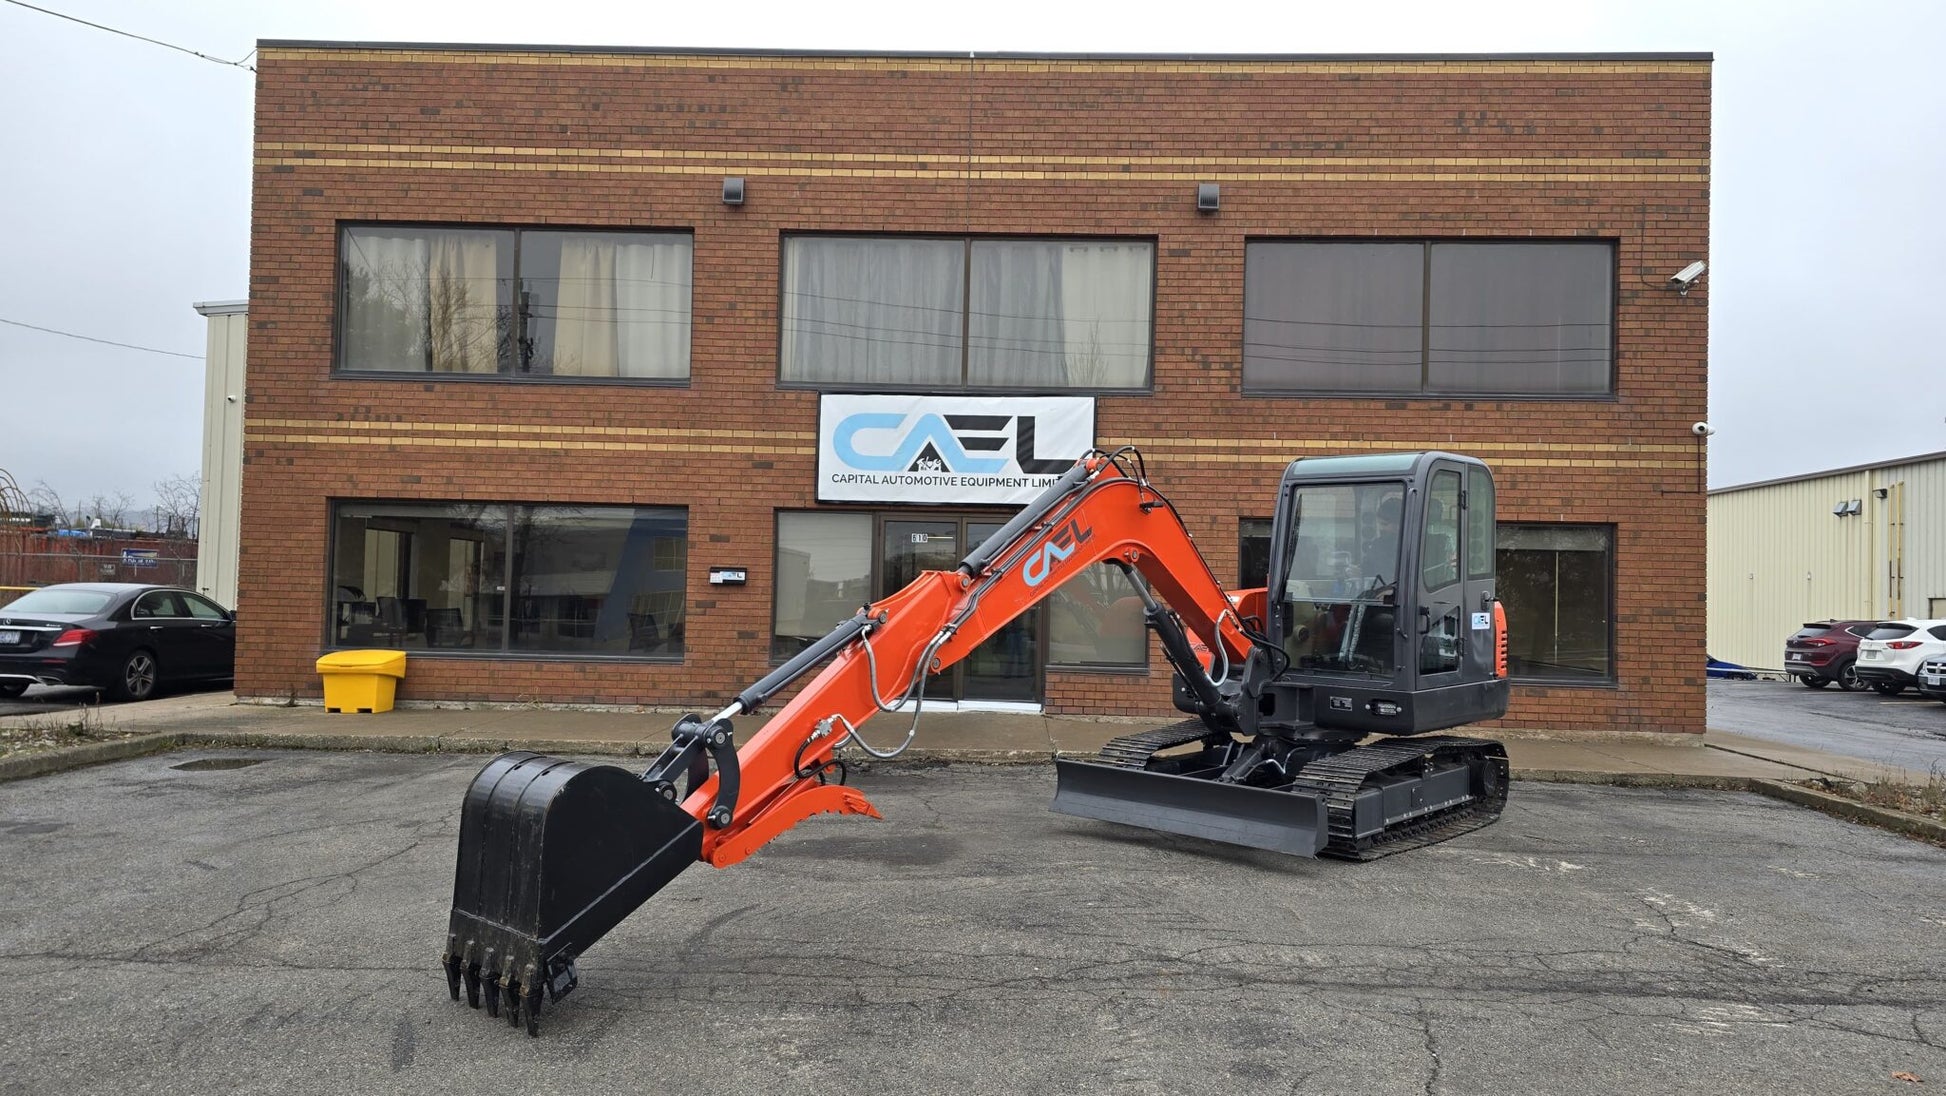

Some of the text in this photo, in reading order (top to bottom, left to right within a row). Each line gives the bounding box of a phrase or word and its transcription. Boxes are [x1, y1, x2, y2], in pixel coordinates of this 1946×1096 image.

[833, 413, 1079, 474] CAEL
[831, 474, 880, 485] CAPITAL
[881, 475, 958, 487] AUTOMOTIVE
[960, 476, 1030, 488] EQUIPMENT
[1023, 519, 1093, 587] CAEL
